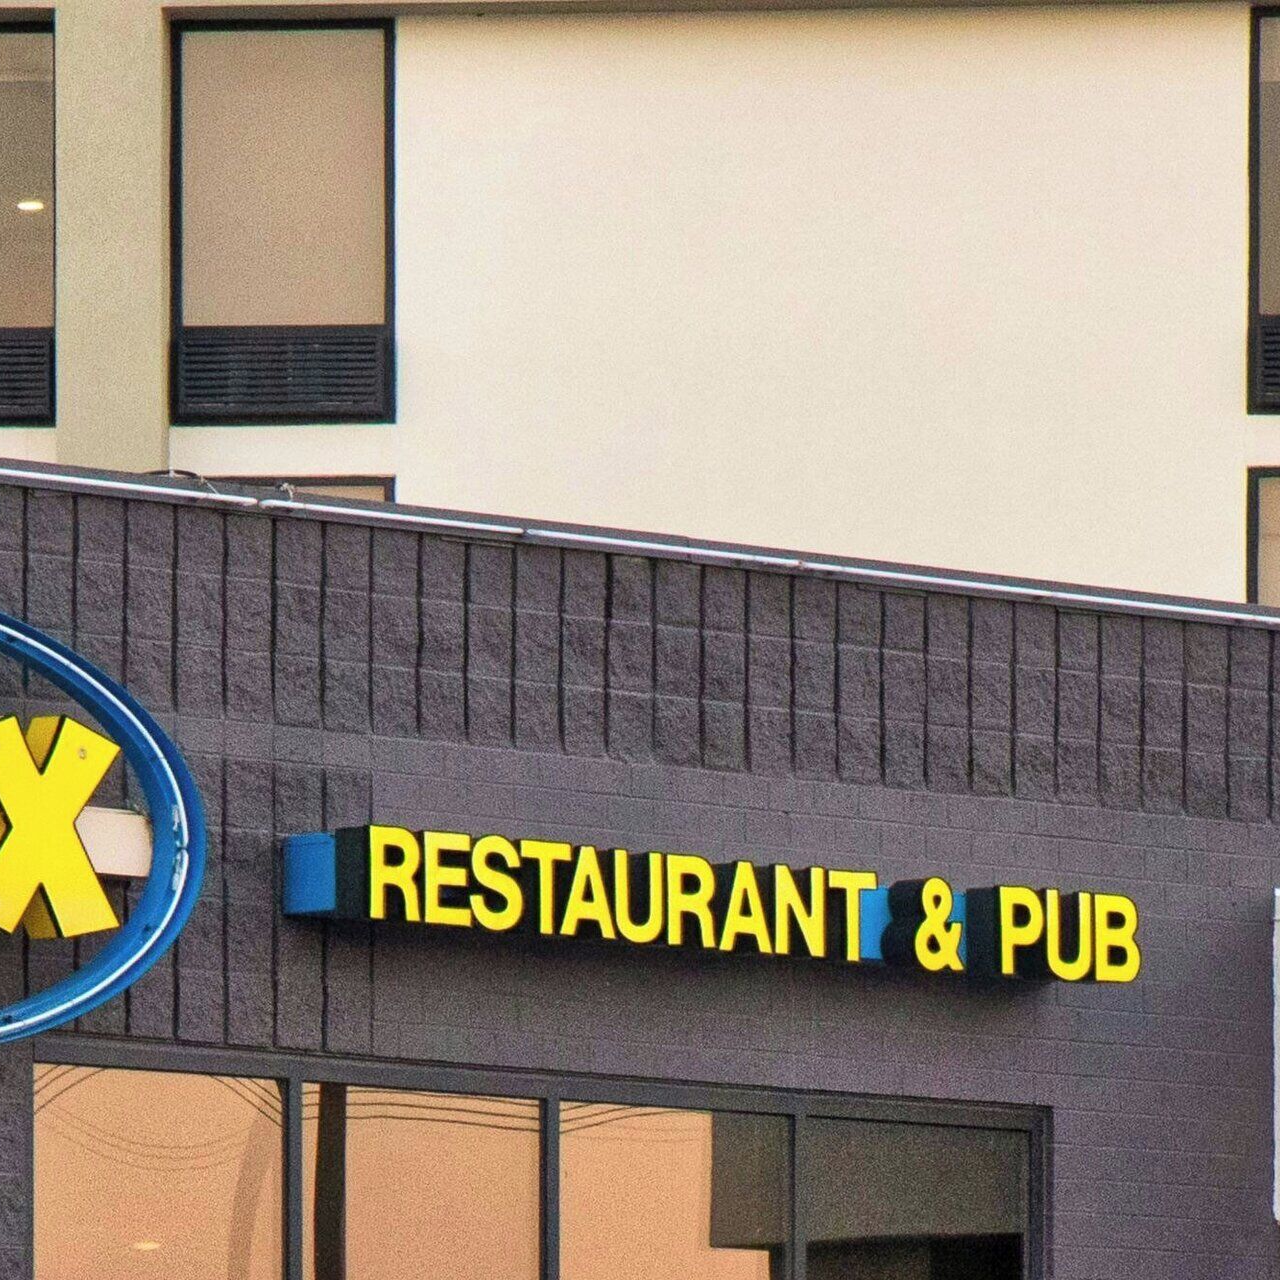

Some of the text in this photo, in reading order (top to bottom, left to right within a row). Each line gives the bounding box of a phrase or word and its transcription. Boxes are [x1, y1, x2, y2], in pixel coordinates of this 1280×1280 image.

[369, 825, 1141, 983] RESTAURANT & PUB
